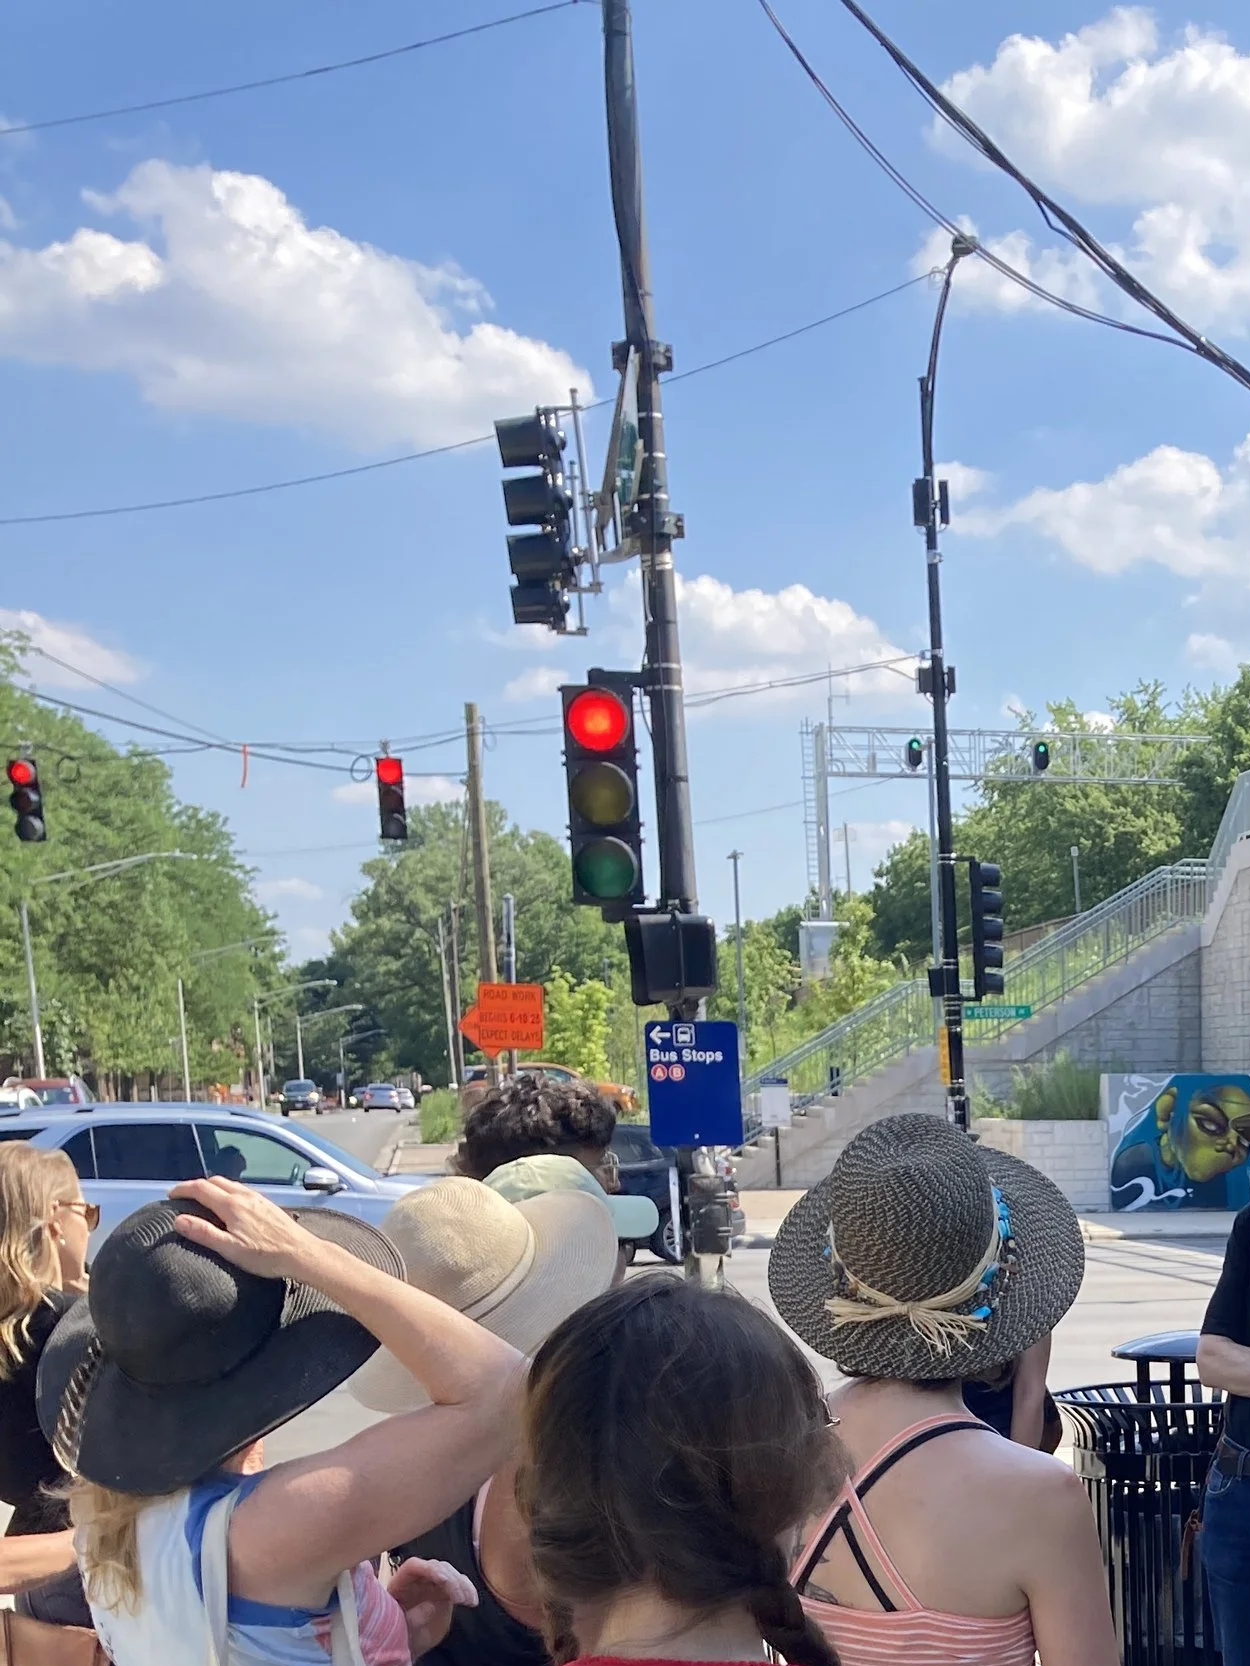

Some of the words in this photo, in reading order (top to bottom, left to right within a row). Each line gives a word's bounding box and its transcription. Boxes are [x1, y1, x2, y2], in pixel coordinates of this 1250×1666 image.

[483, 989, 508, 1001] ROAD
[511, 991, 537, 1002] WORK
[974, 1006, 1016, 1018] PETERSON
[481, 1029, 508, 1041] EXPECT
[511, 1029, 541, 1042] DELAYS
[649, 1048, 678, 1062] Bus
[681, 1048, 724, 1065] Stops
